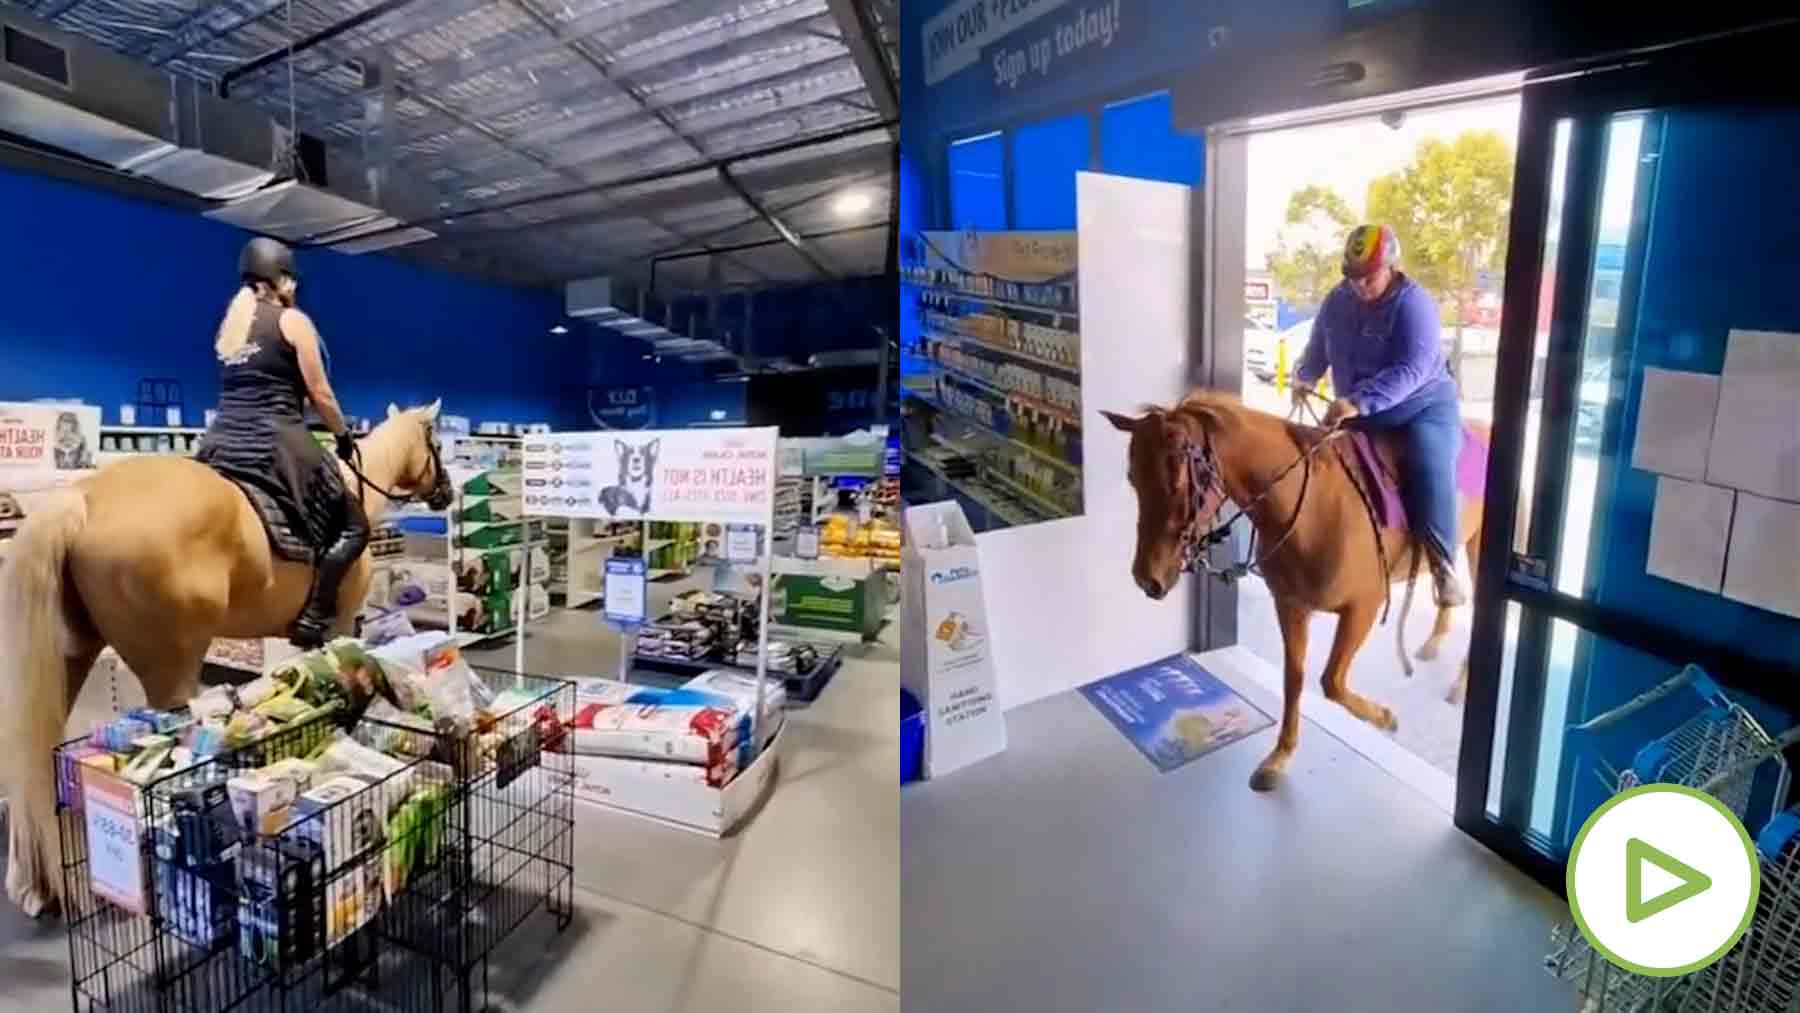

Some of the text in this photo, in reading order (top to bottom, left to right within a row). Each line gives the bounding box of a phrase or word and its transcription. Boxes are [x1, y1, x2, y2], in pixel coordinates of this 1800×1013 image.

[958, 0, 988, 45] OUR
[992, 0, 1119, 88] Sign up today!
